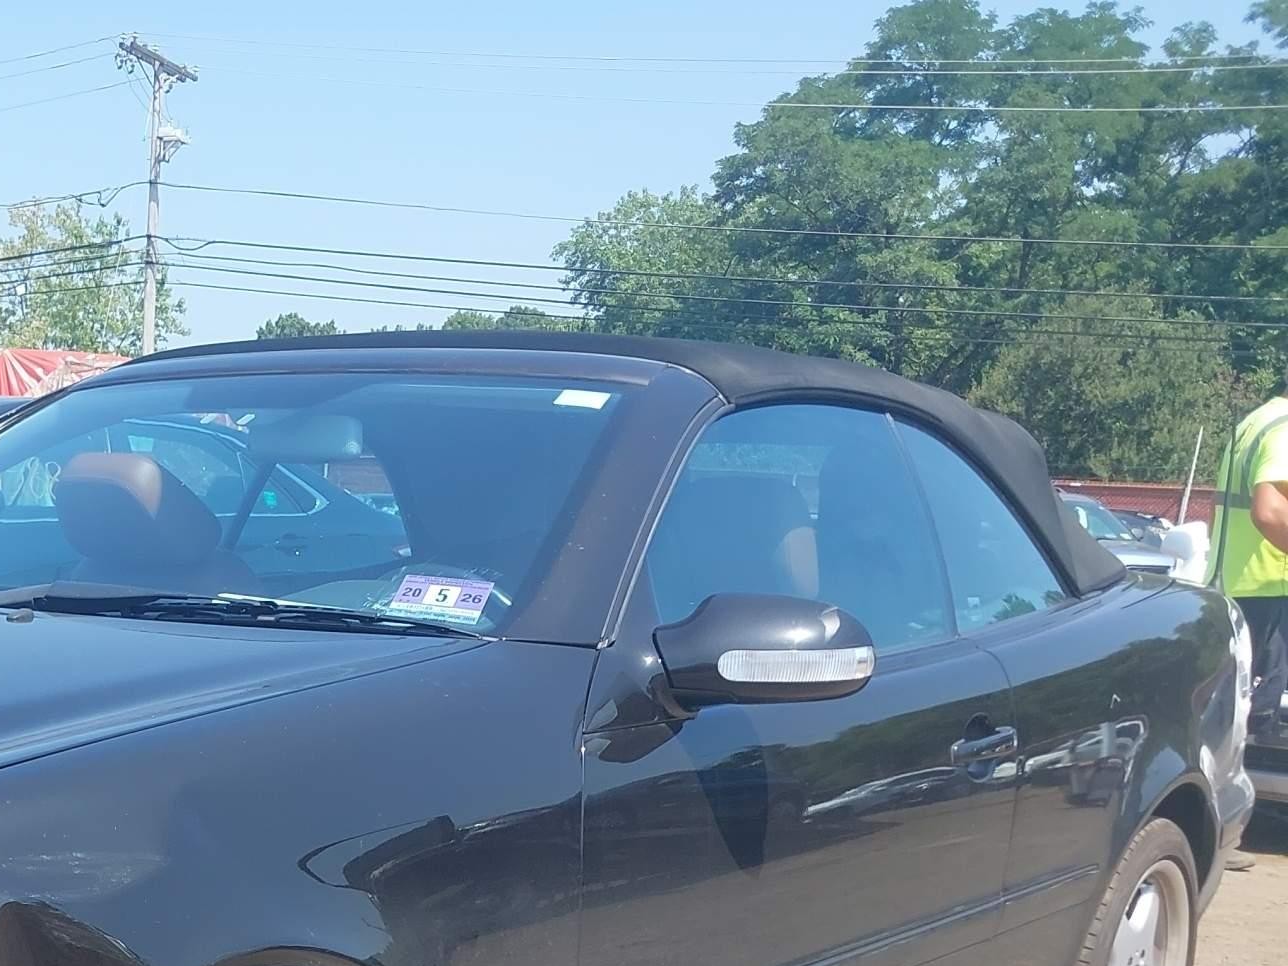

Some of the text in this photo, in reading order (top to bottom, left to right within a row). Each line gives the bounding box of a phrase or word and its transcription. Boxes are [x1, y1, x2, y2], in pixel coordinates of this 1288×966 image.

[402, 587, 483, 604] 20 5 26
